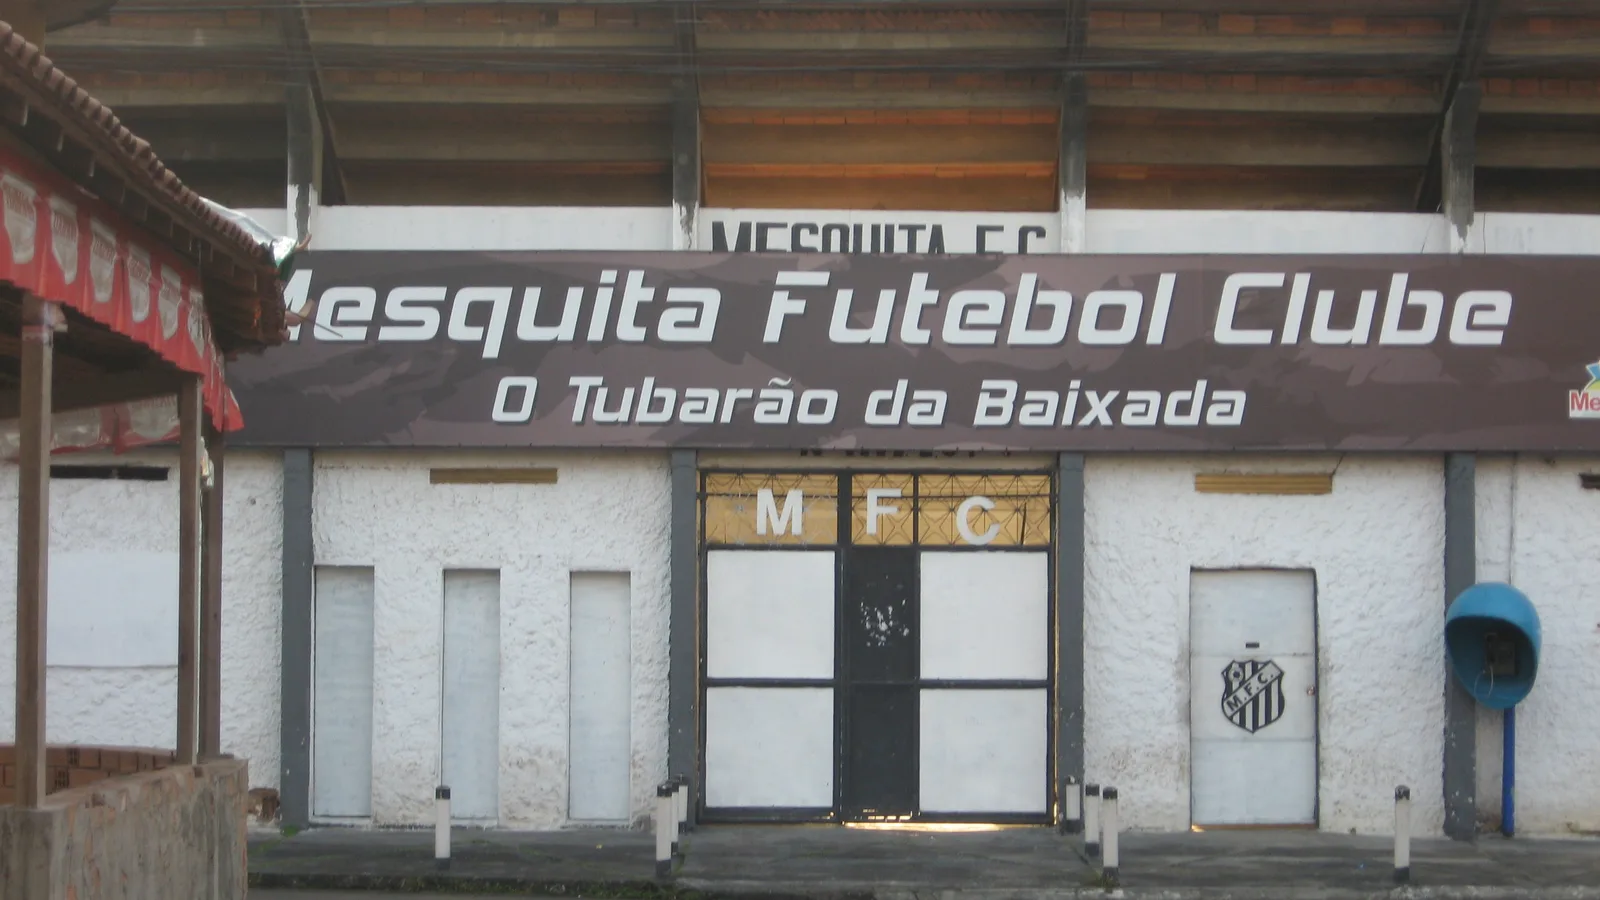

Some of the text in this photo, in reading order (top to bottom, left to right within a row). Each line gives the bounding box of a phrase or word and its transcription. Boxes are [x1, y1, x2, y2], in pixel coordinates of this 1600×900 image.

[763, 271, 1177, 345] Futebol
[1213, 272, 1513, 345] Clube
[491, 376, 1247, 426] O Tubarão da Baixada
